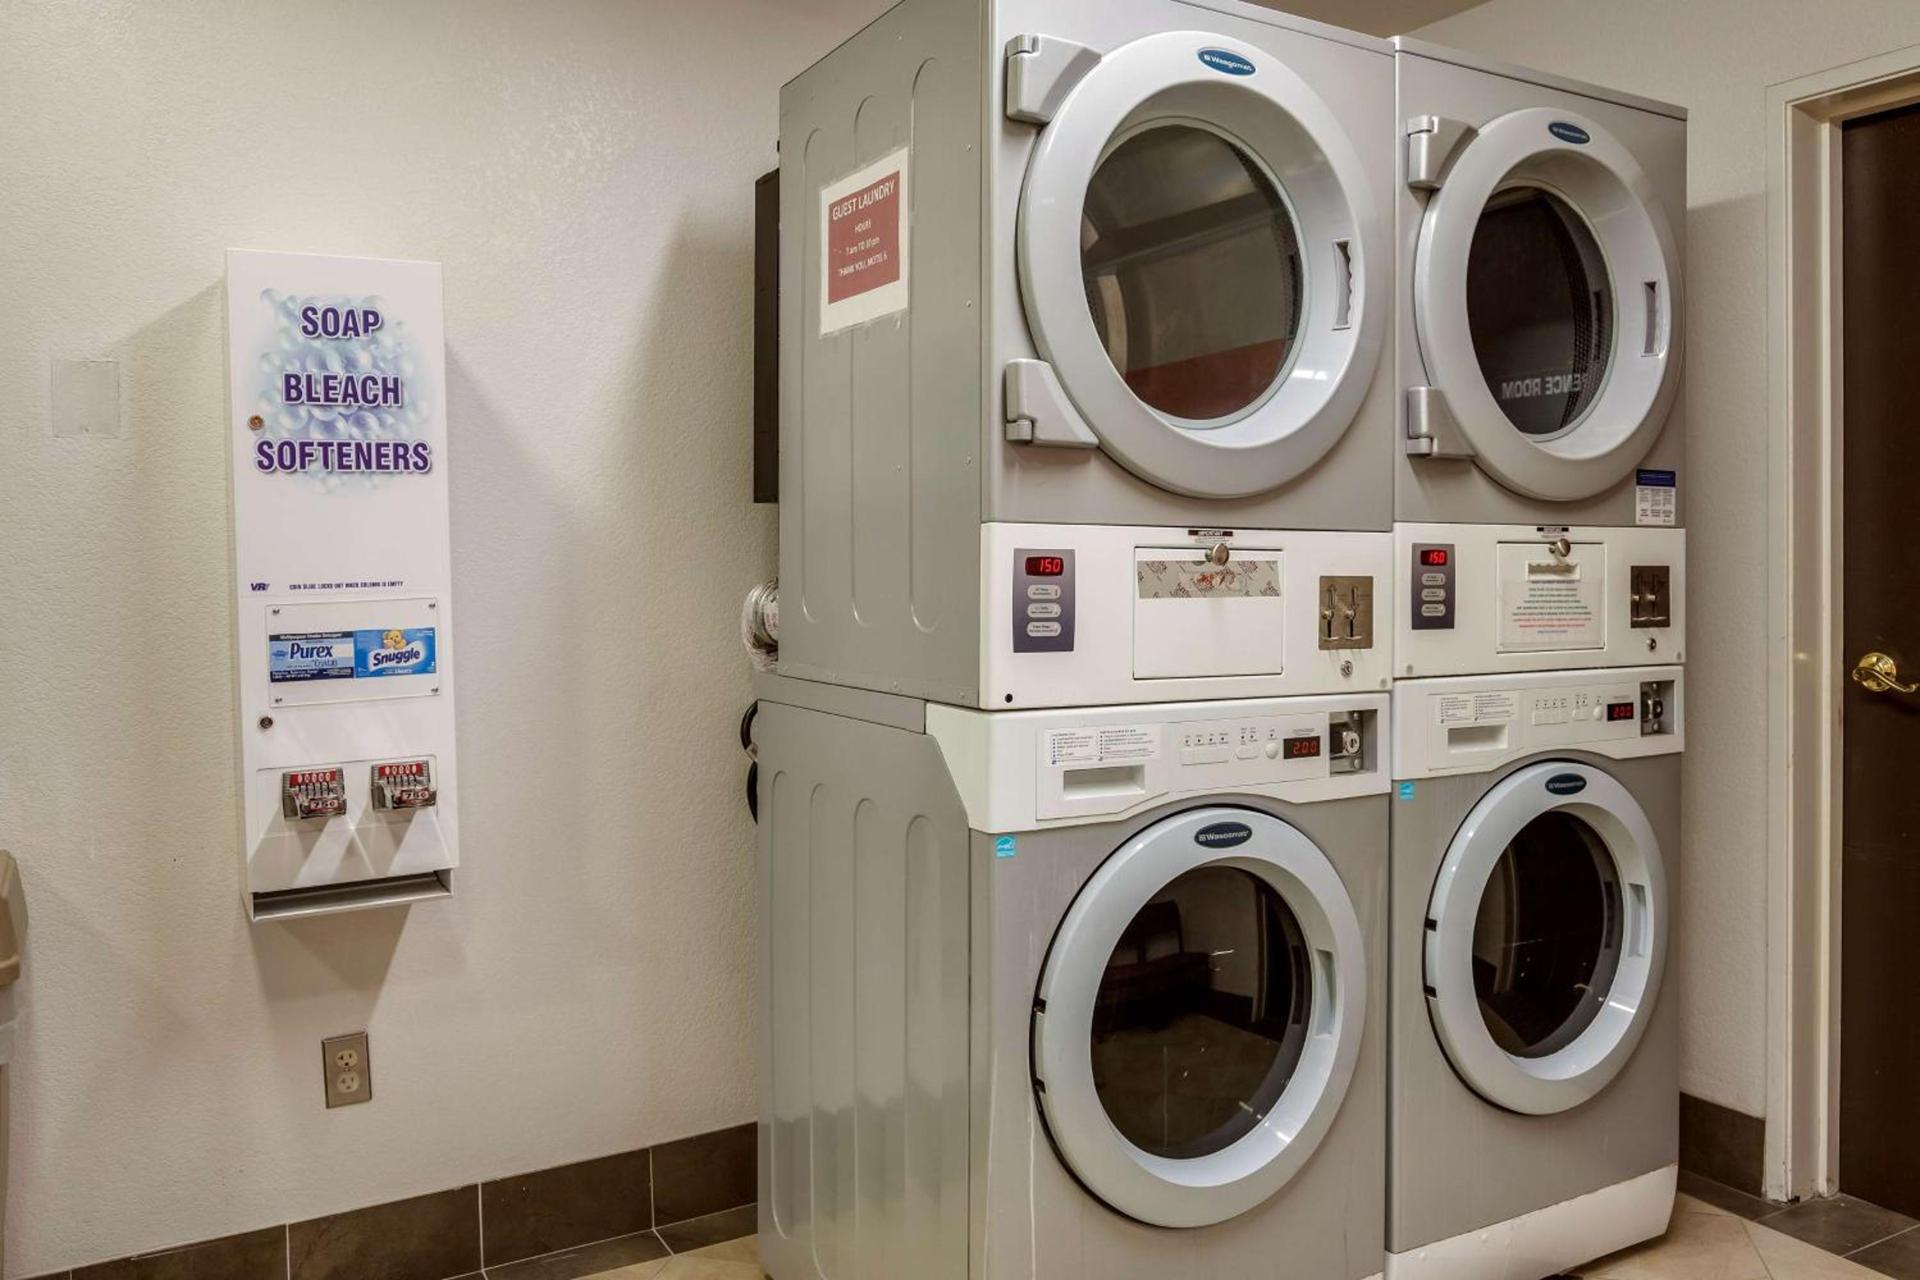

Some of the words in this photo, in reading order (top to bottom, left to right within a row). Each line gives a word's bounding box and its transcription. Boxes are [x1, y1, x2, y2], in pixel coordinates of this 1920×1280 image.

[832, 198, 857, 220] GUEST
[858, 179, 895, 210] LAUNDRY
[300, 305, 382, 338] SOAP
[283, 372, 402, 405] BLEACH
[256, 440, 431, 472] SOFTENERS
[1039, 558, 1061, 573] 150
[1429, 551, 1446, 564] 150
[290, 642, 333, 659] Purex
[373, 648, 421, 667] Snuggle
